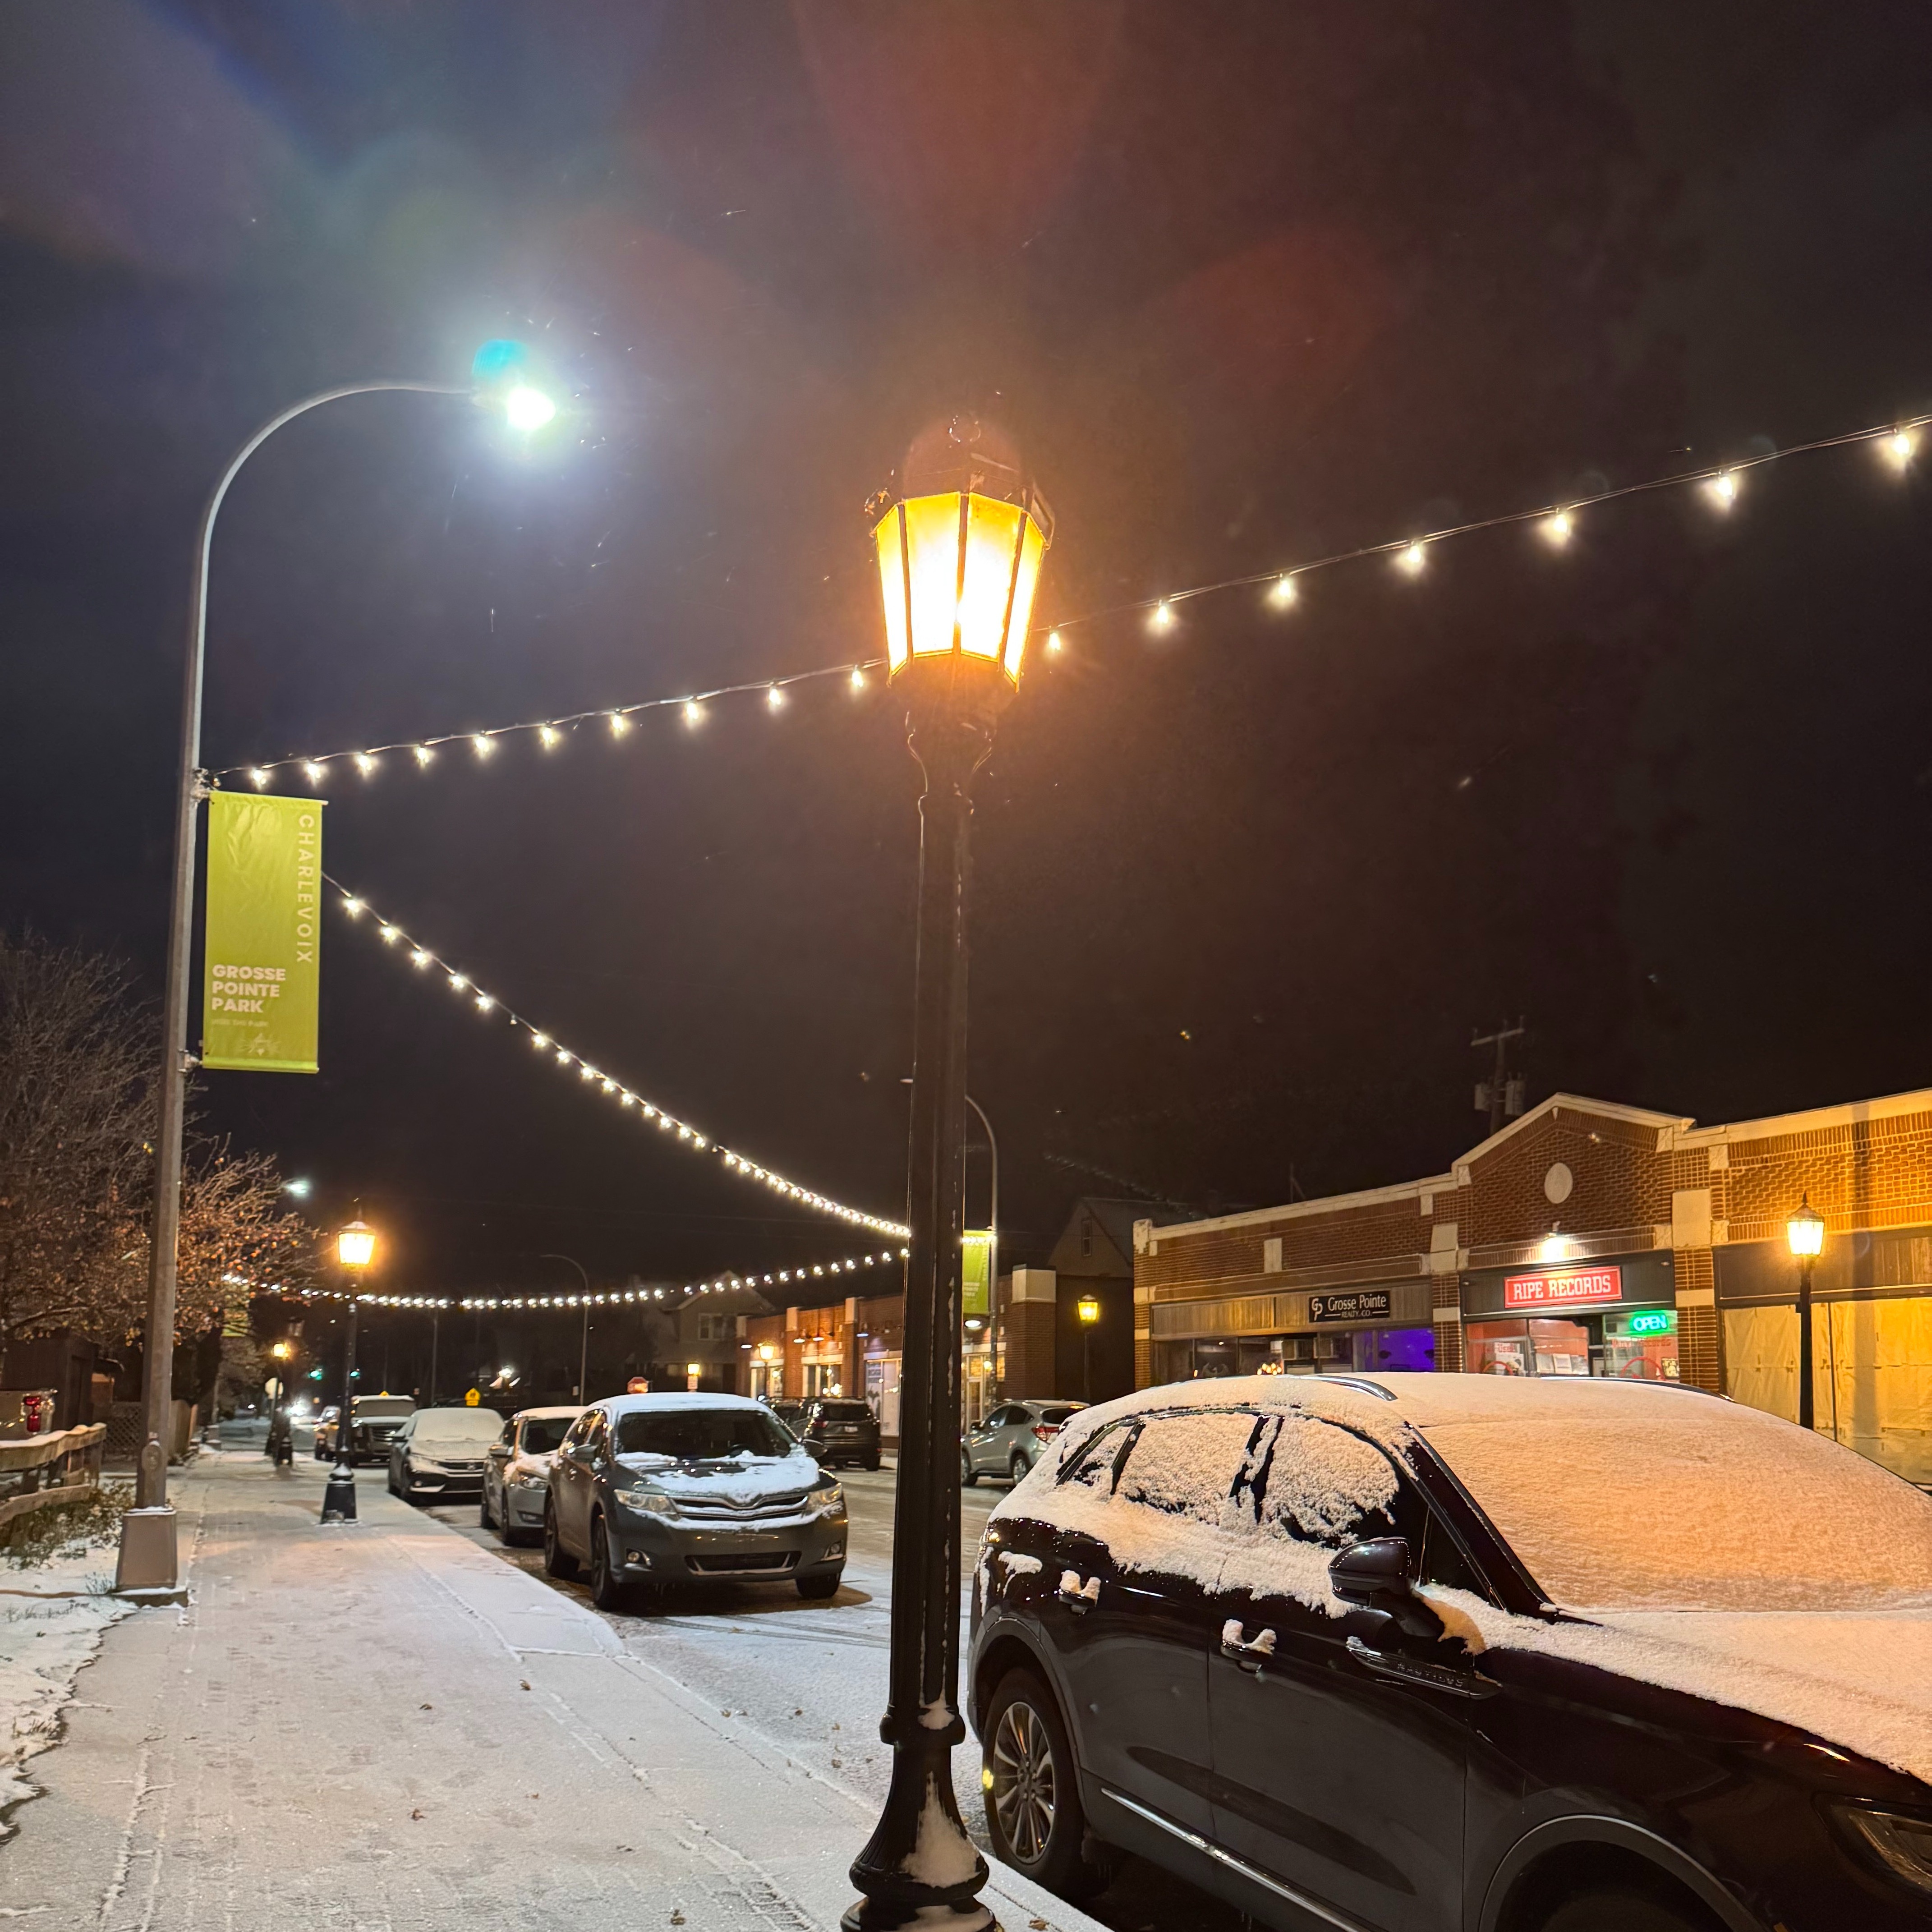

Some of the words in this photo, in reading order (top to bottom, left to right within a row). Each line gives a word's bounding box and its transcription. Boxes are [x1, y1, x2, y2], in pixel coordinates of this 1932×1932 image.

[296, 814, 314, 962] CHARLEVOIX
[212, 964, 286, 981] GROSSE
[212, 981, 280, 997] POINTE
[212, 997, 264, 1013] PARK
[1513, 1281, 1544, 1300] RIPE
[1548, 1275, 1611, 1298] RECORDS
[1328, 1297, 1356, 1311] Grosse
[1359, 1294, 1386, 1309] Pointe
[1633, 1315, 1667, 1331] OPEN
